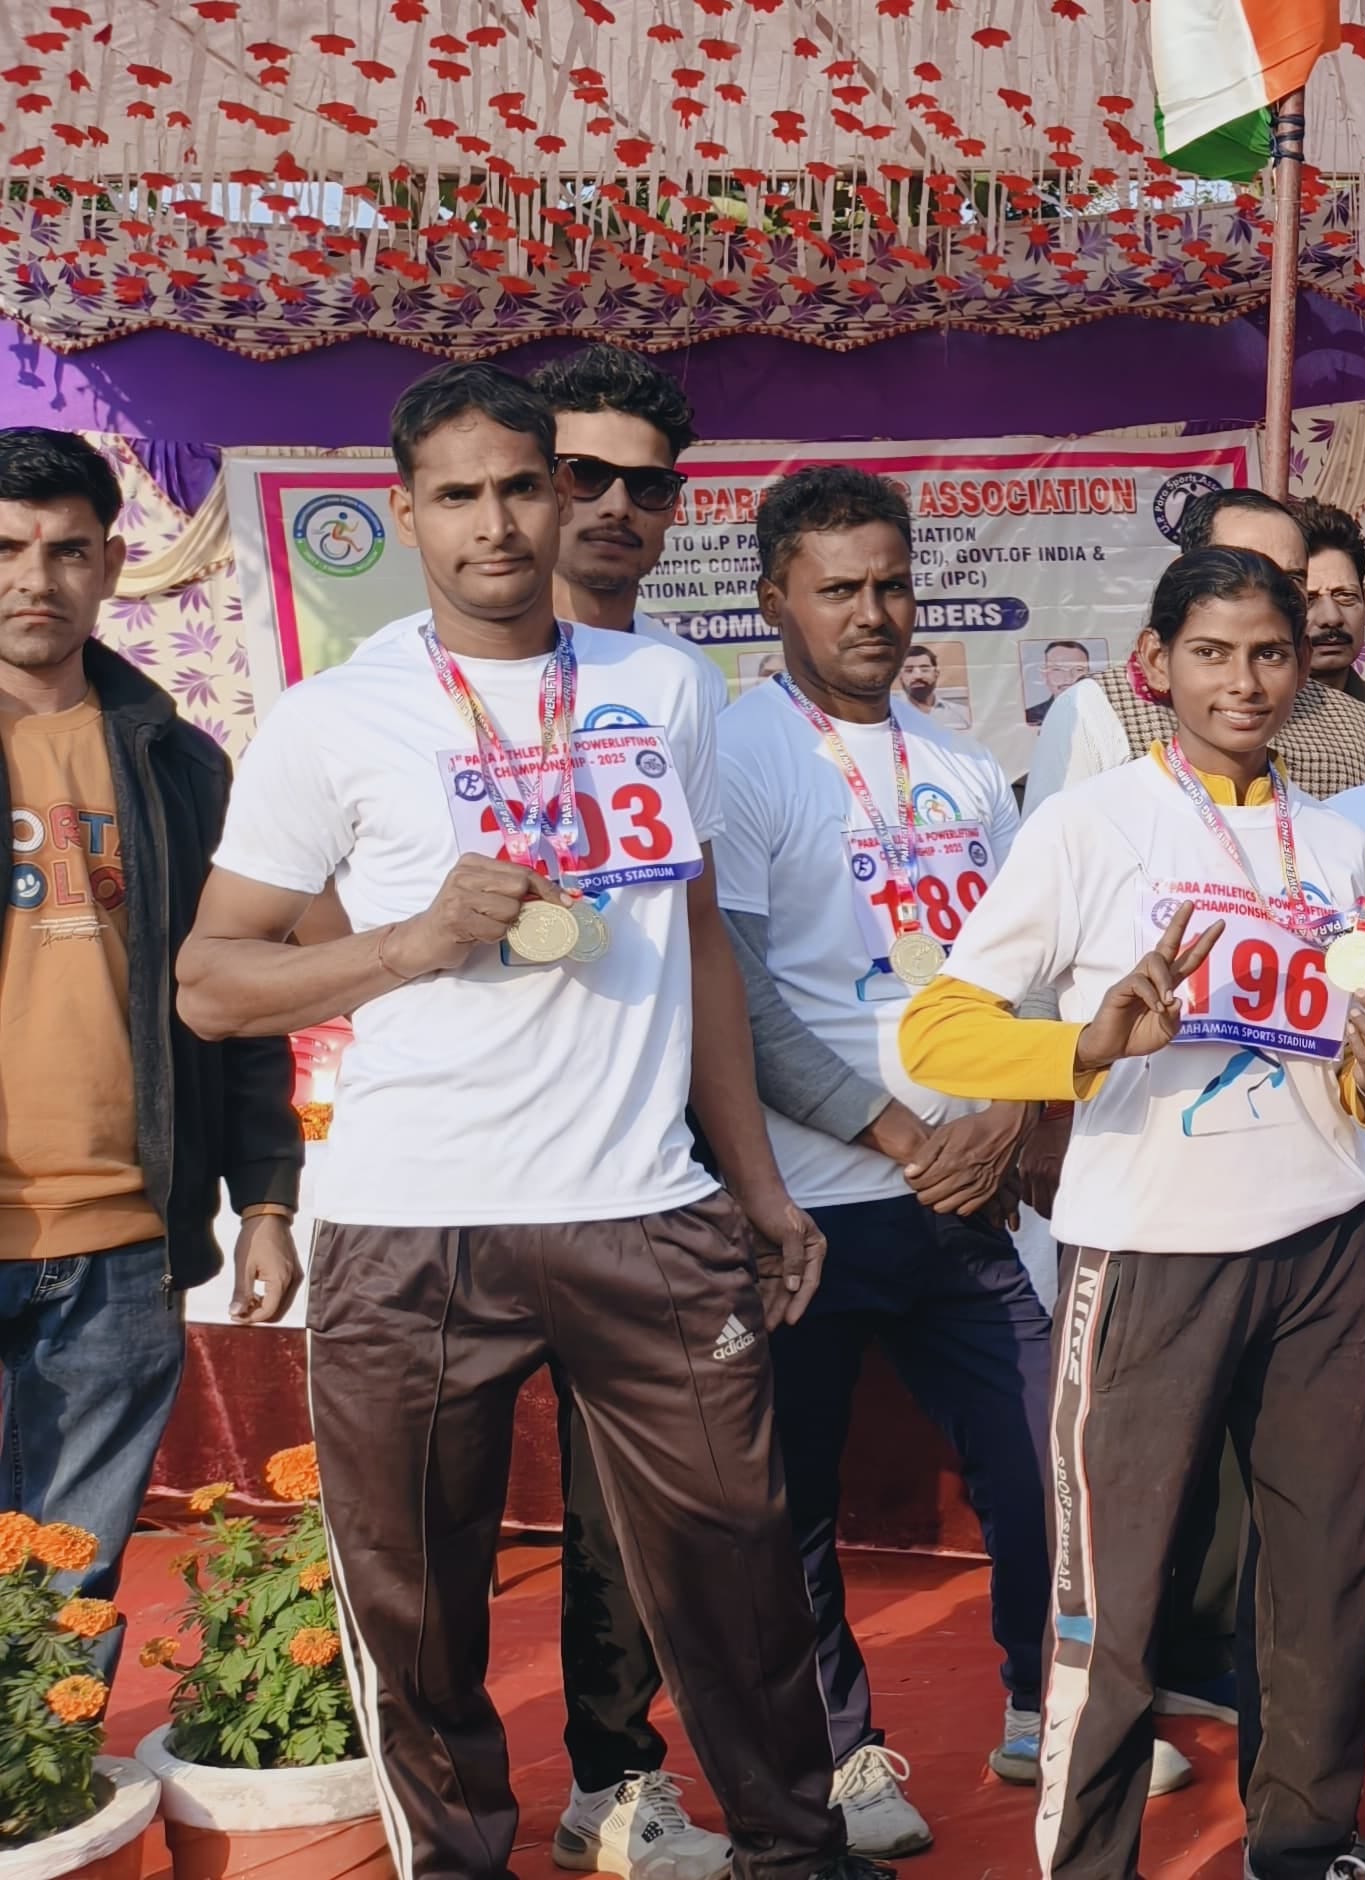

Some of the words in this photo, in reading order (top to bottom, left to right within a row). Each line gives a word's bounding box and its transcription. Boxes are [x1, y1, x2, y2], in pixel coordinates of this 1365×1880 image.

[919, 477, 1137, 518] ASSOCIATION
[911, 528, 976, 543] CIATION
[1039, 547, 1086, 562] INDIA
[1094, 547, 1105, 561] &
[941, 572, 987, 588] (IPC)
[914, 604, 1002, 628] MBERS
[574, 737, 657, 753] POWERLIFTING
[599, 753, 627, 767] 2025
[578, 872, 623, 890] SPORTS
[625, 867, 675, 883] STADIUM
[1203, 882, 1257, 903] ATHLETICS
[1178, 932, 1329, 1031] 196
[1242, 1027, 1276, 1043] SPORTS
[1278, 1033, 1316, 1050] STADIUM
[712, 1331, 756, 1360] adidas
